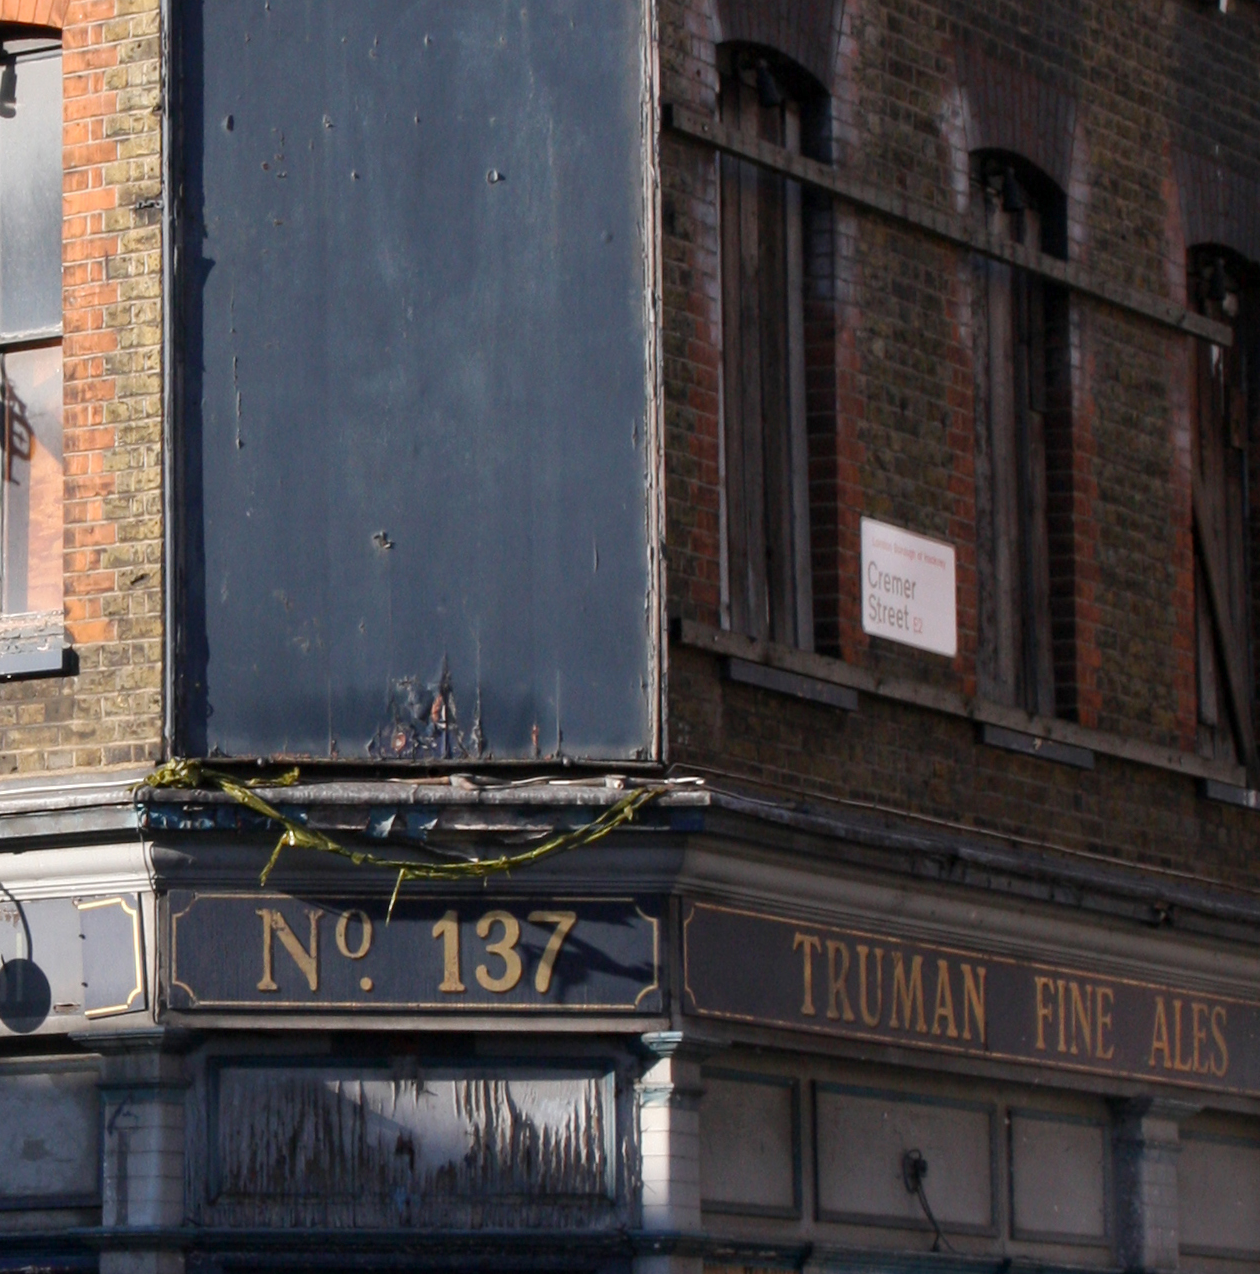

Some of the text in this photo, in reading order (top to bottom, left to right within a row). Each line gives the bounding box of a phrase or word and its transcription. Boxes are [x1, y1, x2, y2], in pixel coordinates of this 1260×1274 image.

[867, 560, 917, 600] Cremer
[868, 594, 910, 630] Street
[431, 910, 578, 994] 137
[792, 932, 1231, 1078] TRUMAN FINE ALES
